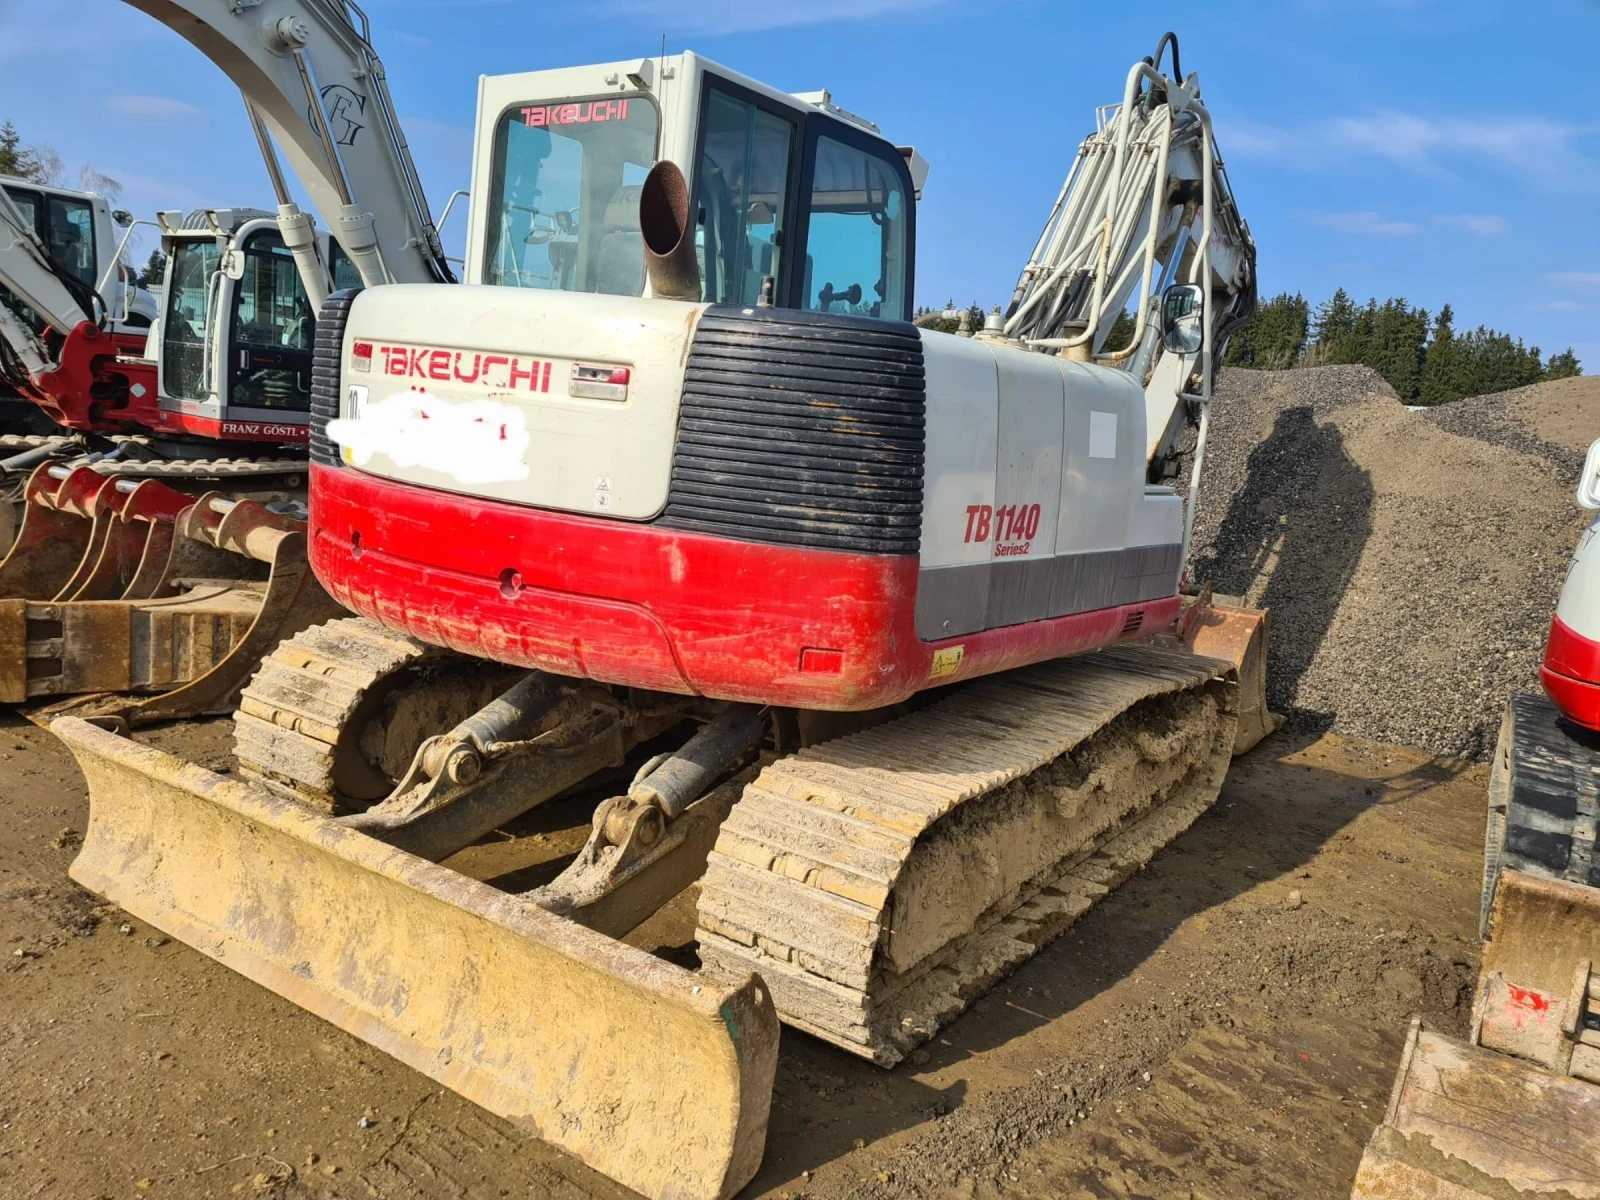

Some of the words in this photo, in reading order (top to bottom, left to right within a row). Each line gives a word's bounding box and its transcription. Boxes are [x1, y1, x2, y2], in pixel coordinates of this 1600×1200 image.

[520, 99, 629, 127] TAKEUCHI
[380, 346, 552, 393] TAKEUCHI
[222, 423, 260, 435] FRANZ
[263, 425, 298, 437] GÖSTL
[995, 541, 1030, 557] Series2
